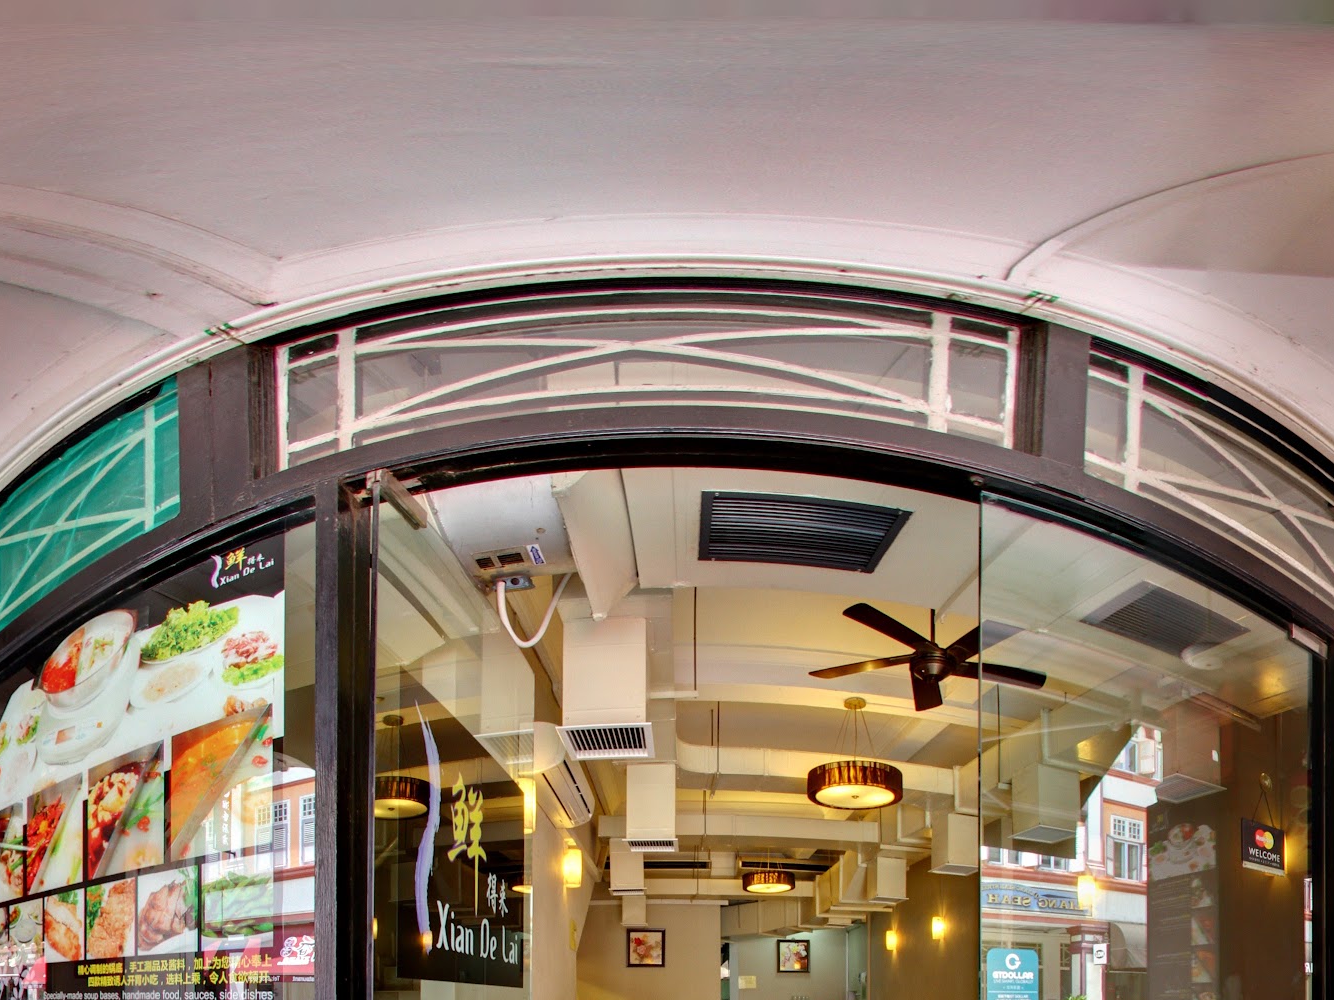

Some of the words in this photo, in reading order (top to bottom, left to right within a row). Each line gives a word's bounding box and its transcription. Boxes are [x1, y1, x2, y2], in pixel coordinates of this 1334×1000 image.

[219, 573, 240, 586] Xian
[242, 567, 256, 576] De
[259, 558, 274, 569] Lai
[1248, 847, 1281, 863] WELCOME
[436, 900, 474, 957] Xian
[480, 918, 496, 960] De
[501, 925, 519, 965] Lai
[100, 990, 121, 1000] bases,
[122, 989, 160, 1000] handmade
[162, 989, 182, 1000] food,
[184, 991, 217, 1000] sauces,
[219, 989, 238, 1000] side
[241, 989, 274, 1000] dishes
